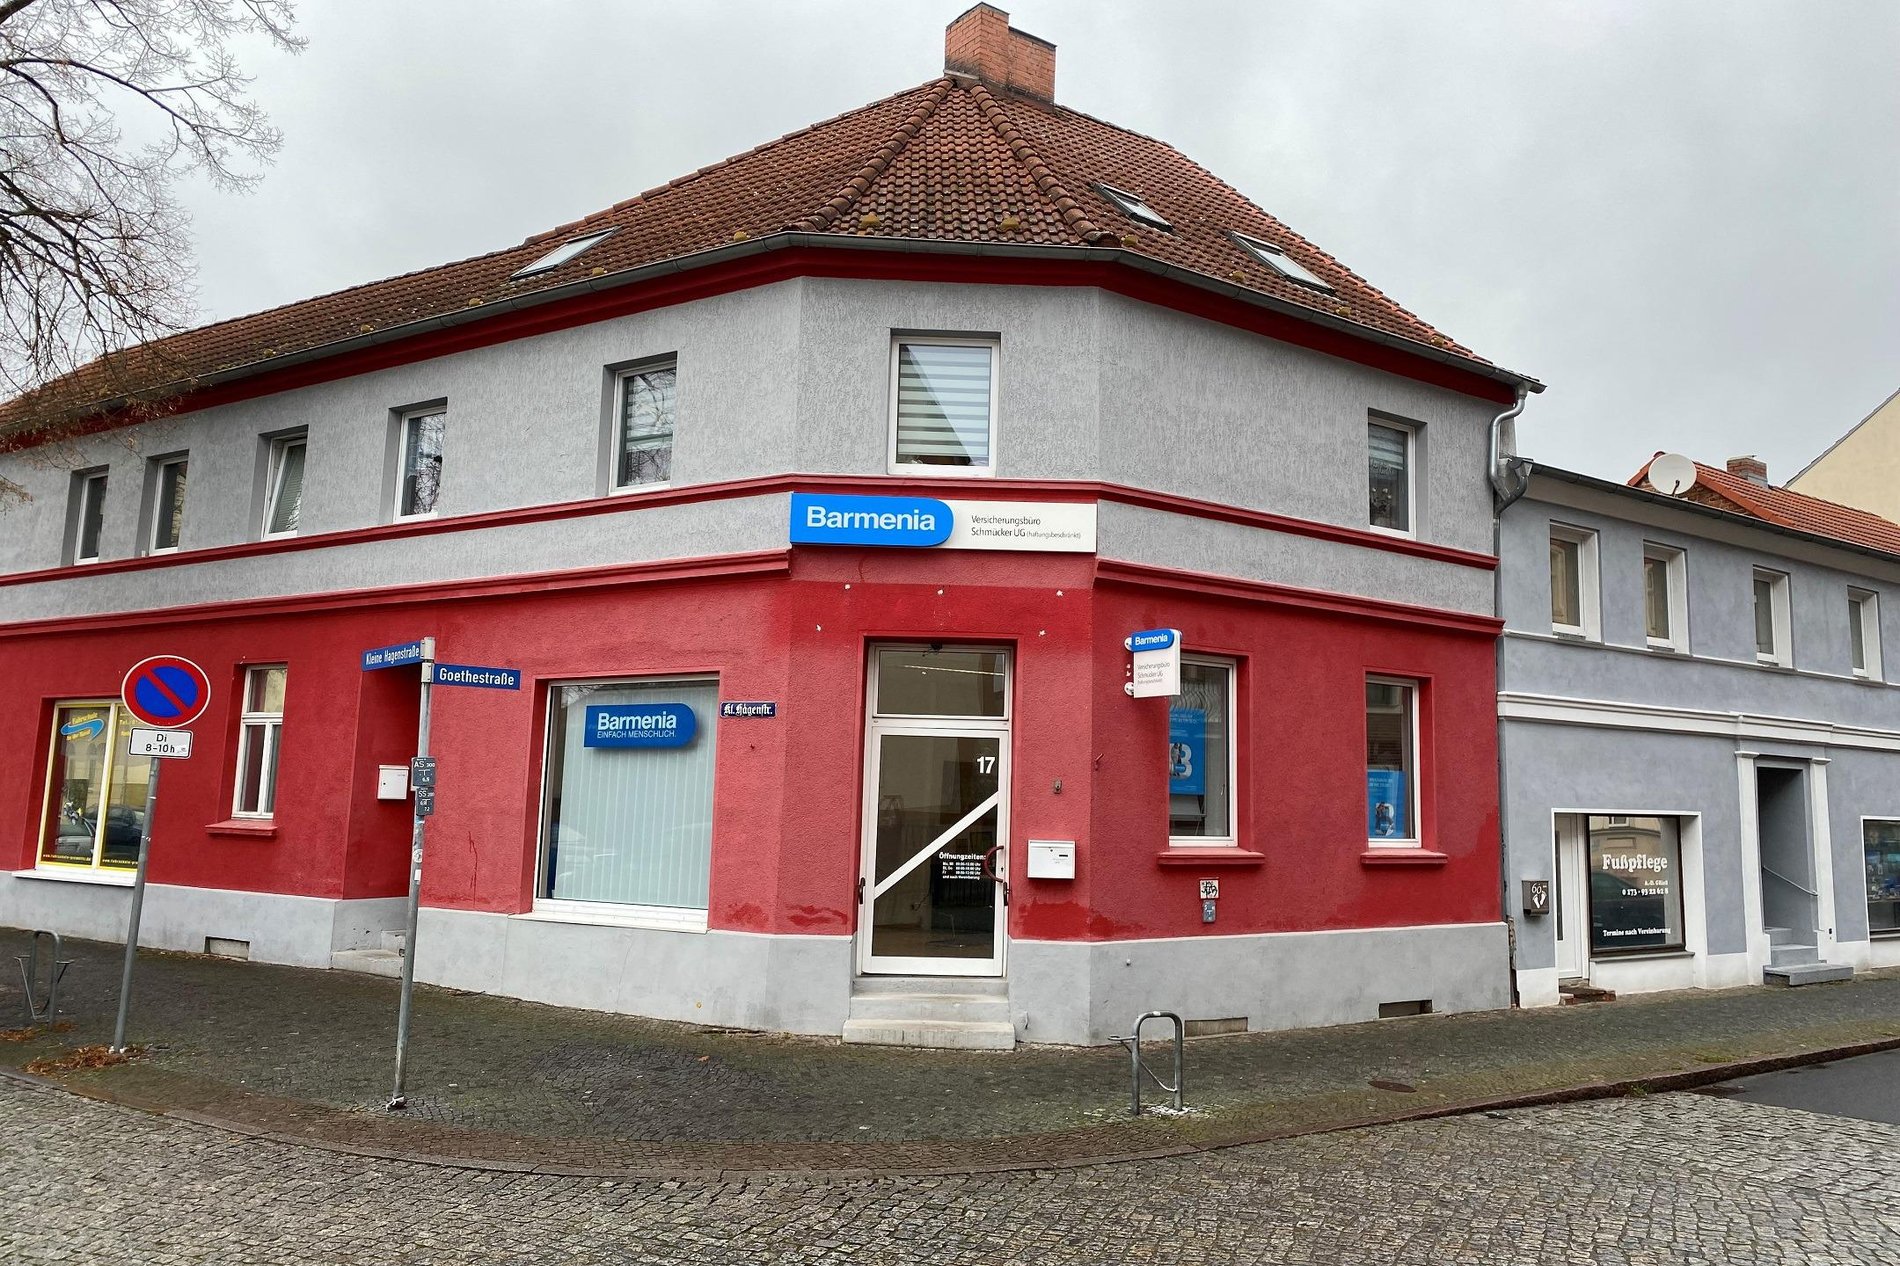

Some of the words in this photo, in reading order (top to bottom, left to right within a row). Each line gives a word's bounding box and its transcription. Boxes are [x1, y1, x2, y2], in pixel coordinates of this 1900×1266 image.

[806, 505, 936, 531] Barmenia
[971, 515, 1041, 527] Versicherungsbüro
[971, 527, 1012, 537] Schmücker
[1013, 528, 1026, 537] UG
[1135, 633, 1168, 646] Barmenia
[366, 653, 383, 666] Kleine
[384, 645, 420, 665] Hagenstraße
[439, 668, 515, 686] Goethestraße
[598, 711, 676, 730] Barmenia
[156, 733, 167, 743] Di
[597, 731, 627, 739] EINFACH
[628, 730, 676, 738] MENSCHLICH.
[414, 760, 424, 769] AS
[976, 756, 996, 774] 17
[418, 790, 427, 798] SS
[1602, 854, 1668, 873] Fußpflege
[1602, 929, 1624, 937] Termine
[1638, 927, 1671, 935] Vereinbarung
